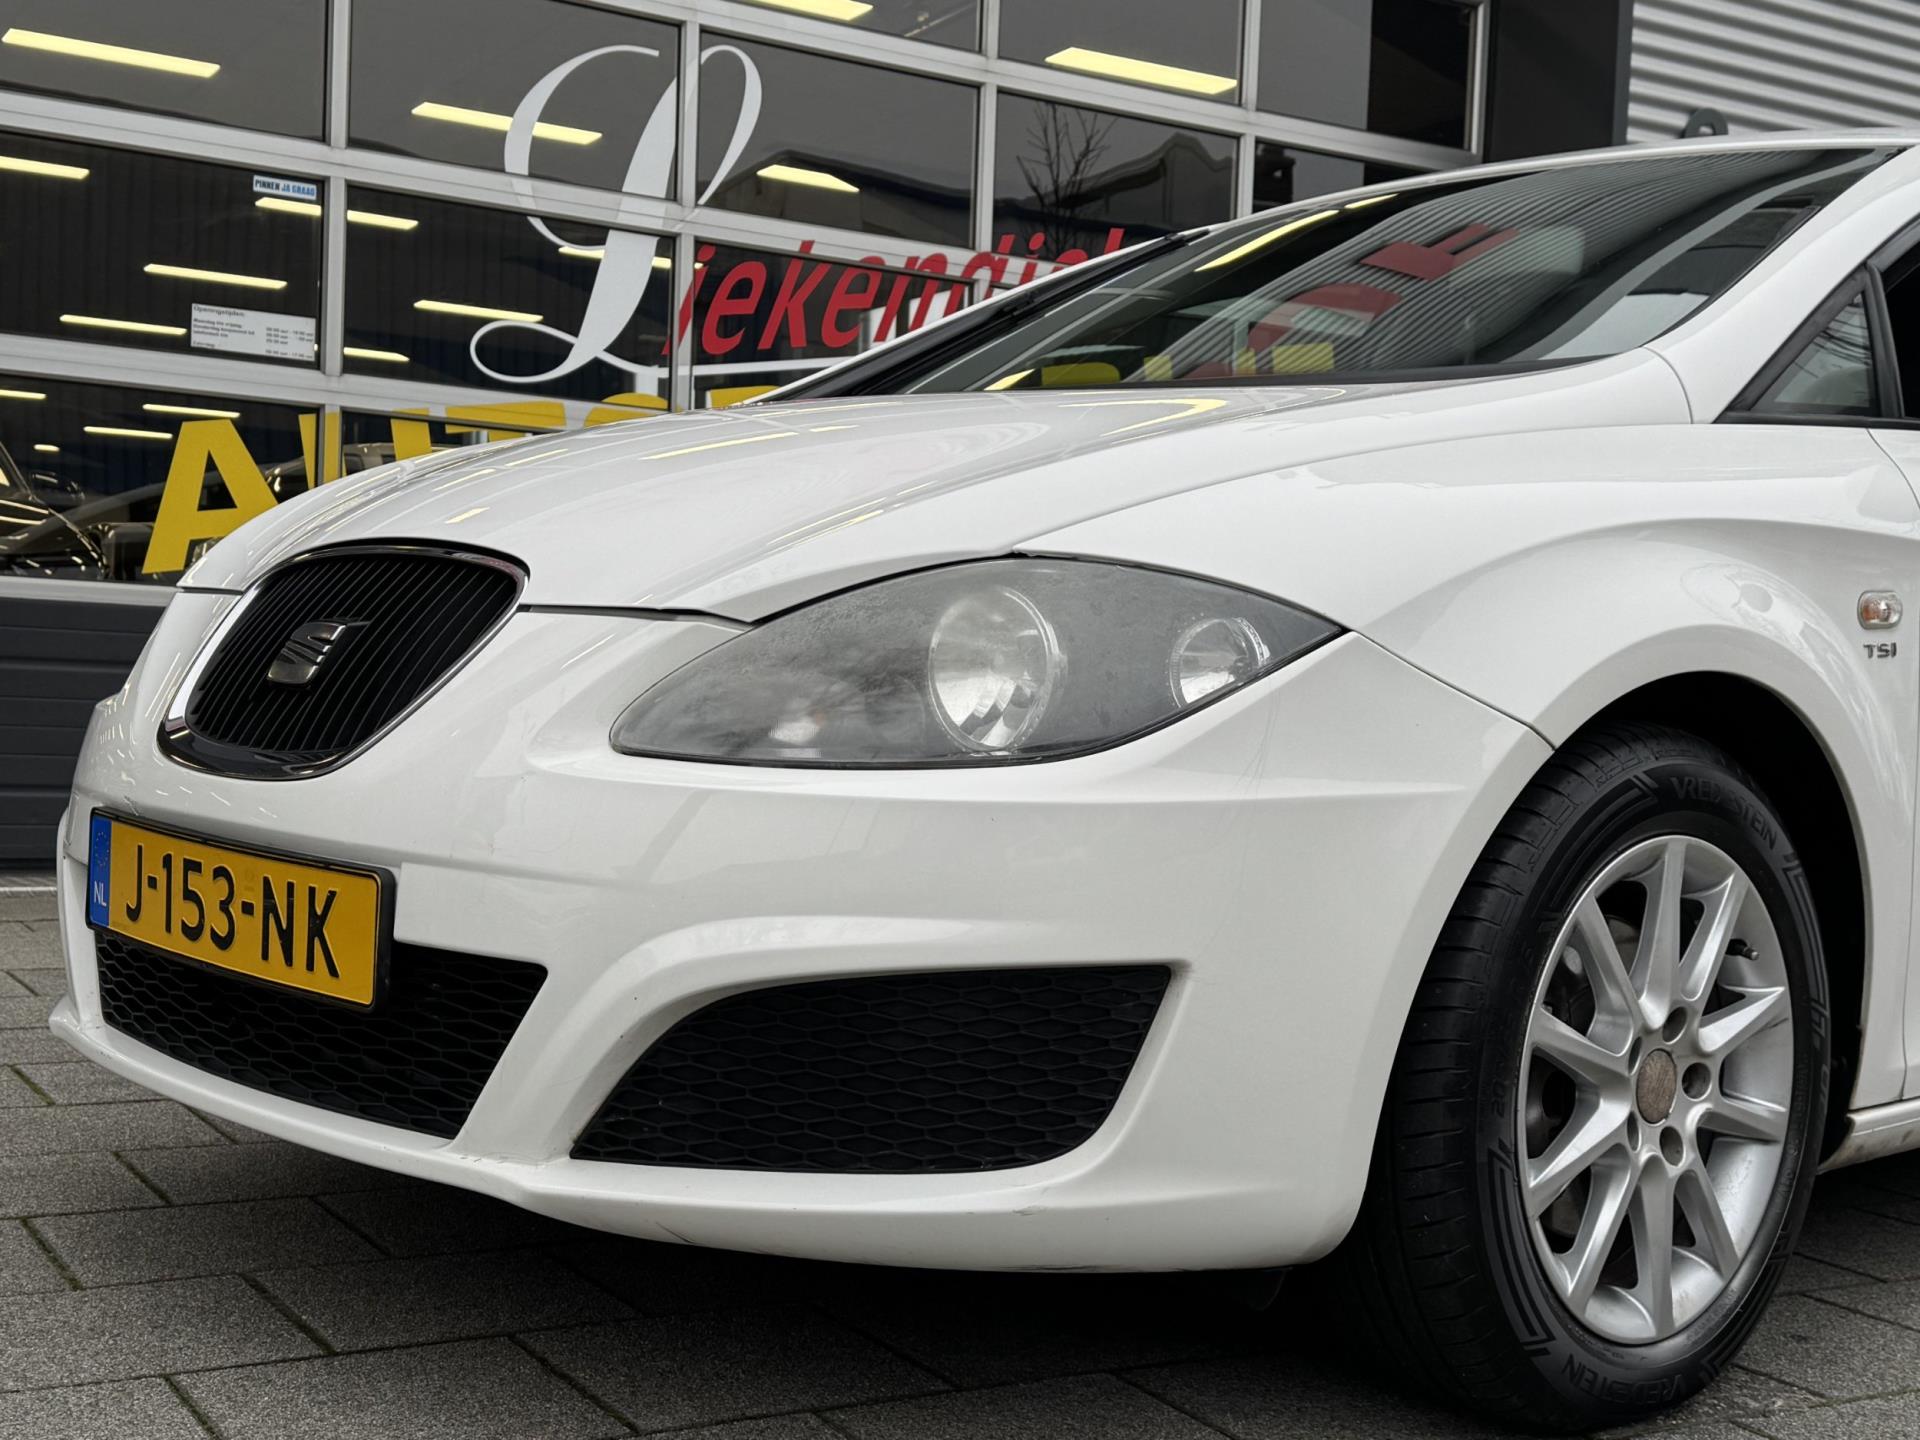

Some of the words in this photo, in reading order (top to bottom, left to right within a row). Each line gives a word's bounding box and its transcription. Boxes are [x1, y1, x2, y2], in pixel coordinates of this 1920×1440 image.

[1863, 642, 1897, 659] TSI
[93, 880, 107, 908] NL
[126, 844, 340, 979] J-153-NK
